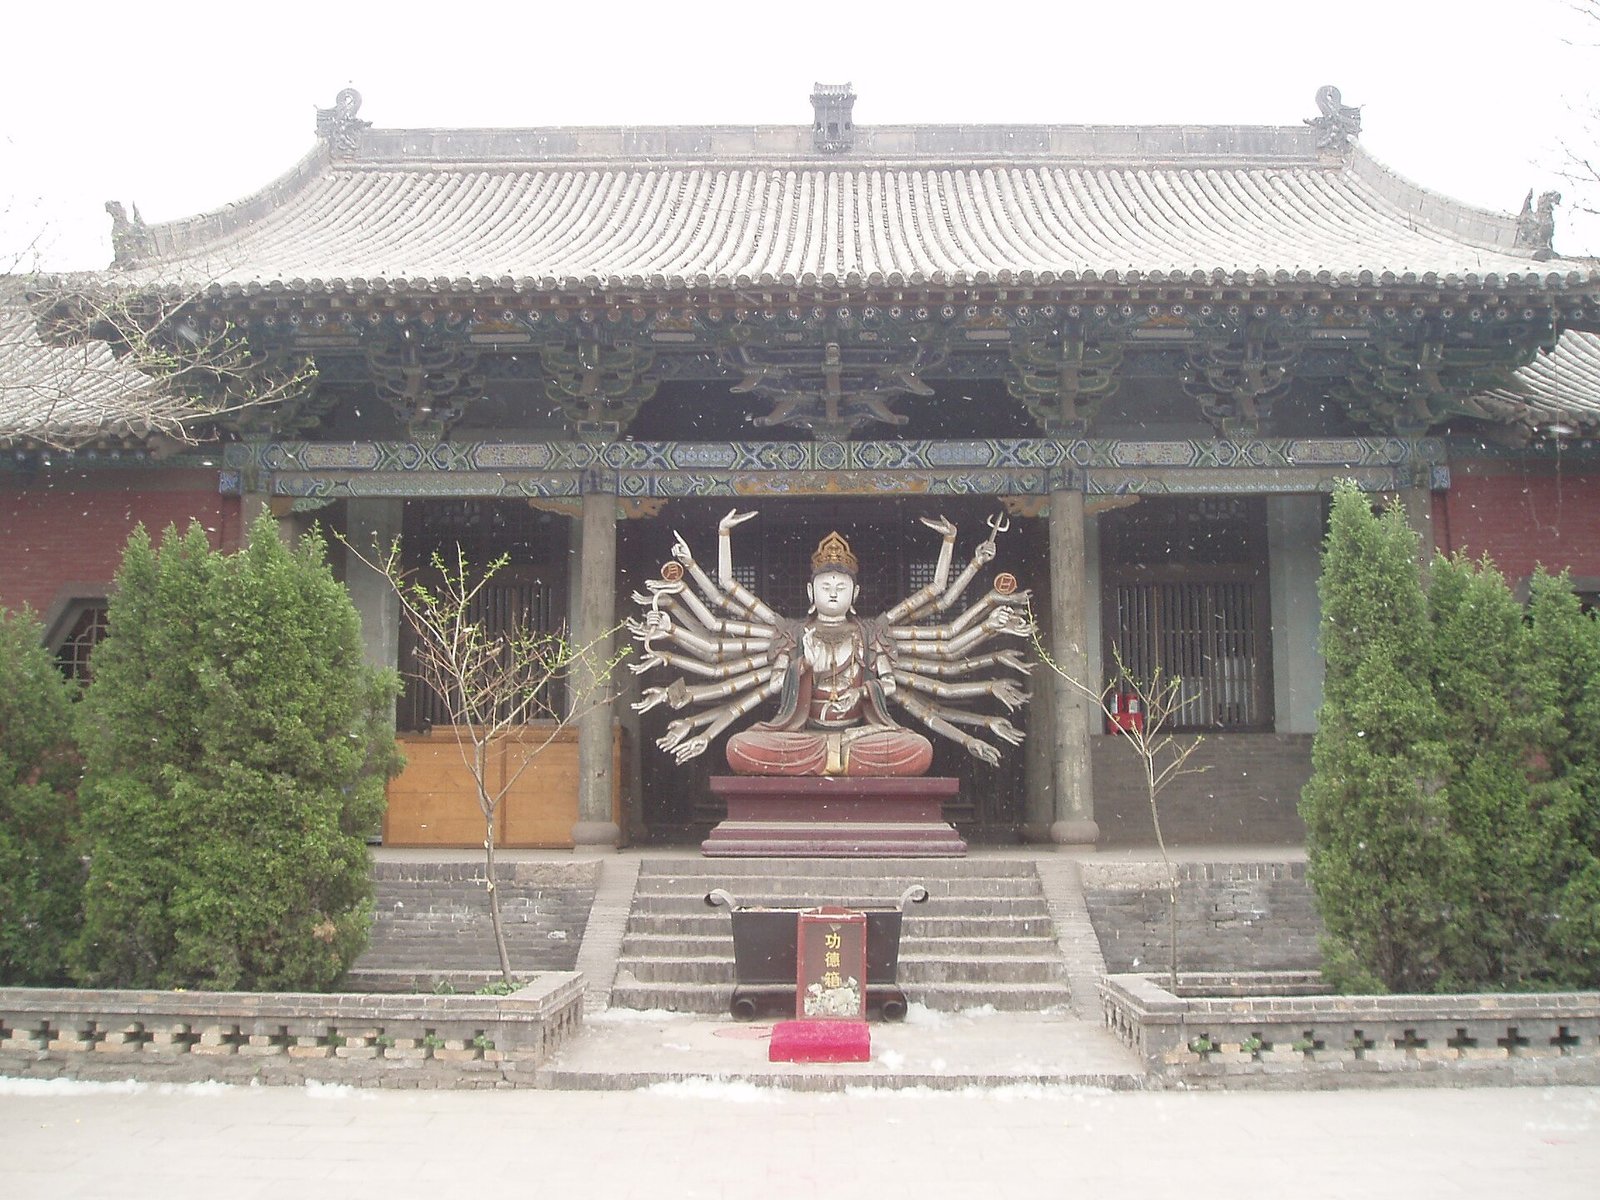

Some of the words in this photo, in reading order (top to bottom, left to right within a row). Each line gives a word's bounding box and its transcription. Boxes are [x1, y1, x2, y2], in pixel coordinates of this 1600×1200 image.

[666, 563, 679, 579] 月
[998, 576, 1013, 592] 日
[824, 932, 841, 987] 功德箱
